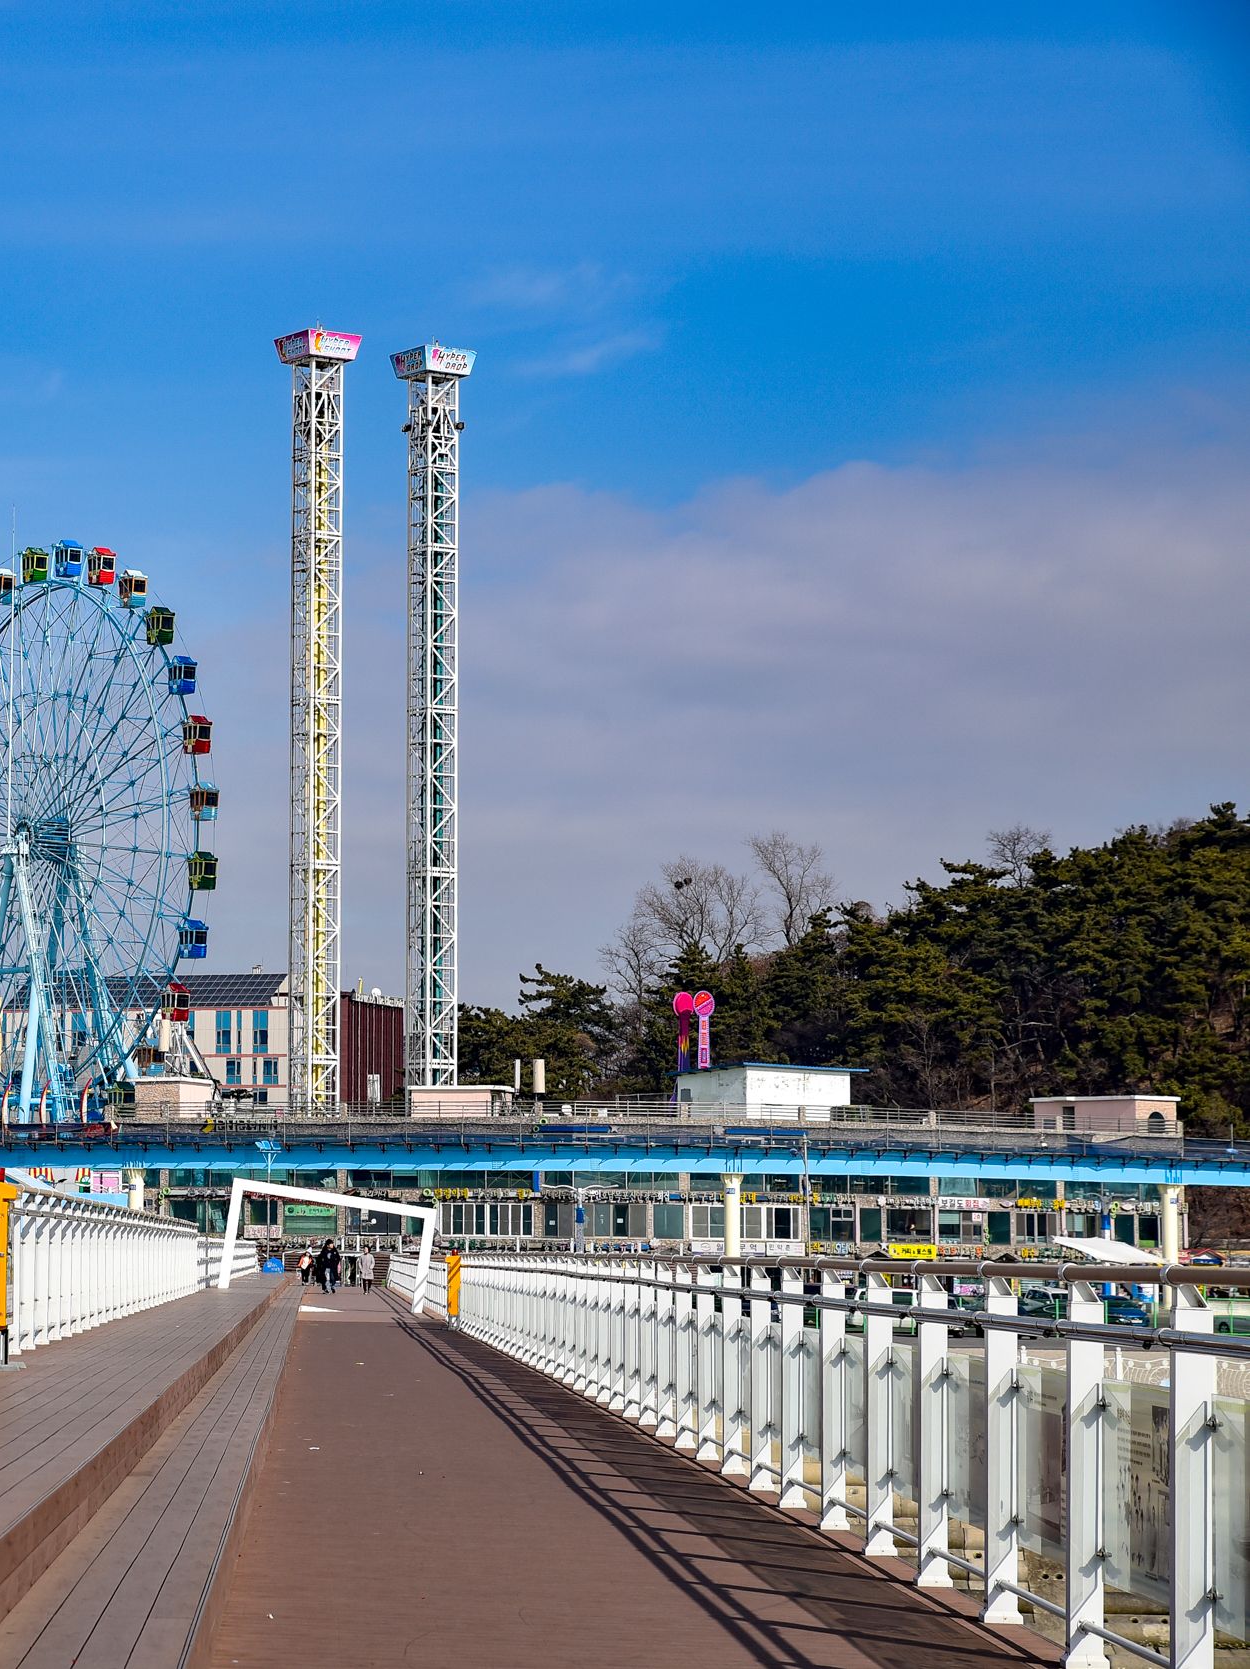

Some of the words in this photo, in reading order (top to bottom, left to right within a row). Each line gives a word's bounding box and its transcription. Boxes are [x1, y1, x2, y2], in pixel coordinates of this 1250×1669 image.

[284, 336, 303, 350] HYPER
[321, 335, 350, 347] HYPER
[324, 345, 352, 354] SHOOT
[400, 350, 422, 368] HYPER
[437, 351, 467, 364] HYPER
[406, 360, 423, 372] DROP
[445, 361, 468, 371] DROP
